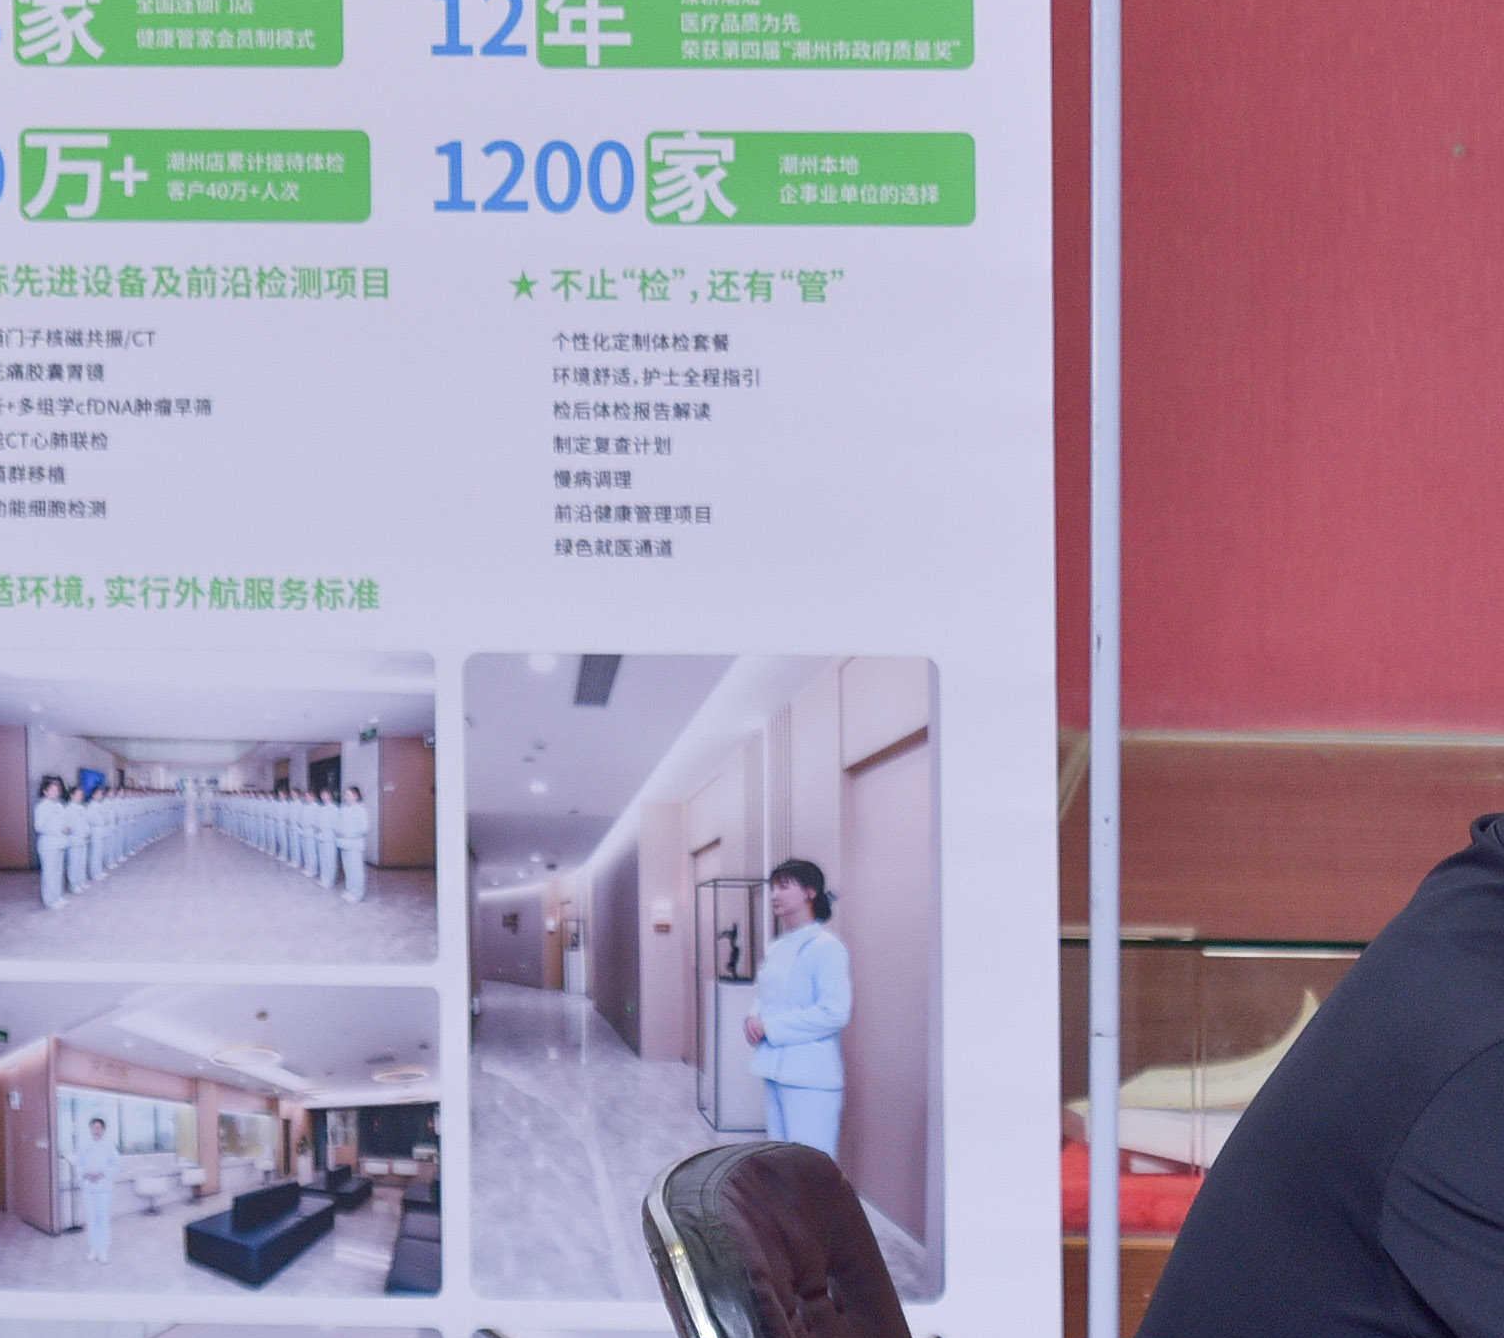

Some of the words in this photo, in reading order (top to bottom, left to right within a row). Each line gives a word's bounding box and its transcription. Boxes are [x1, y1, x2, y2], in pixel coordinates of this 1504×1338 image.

[679, 12, 801, 34] 医疗品质为先
[135, 28, 316, 51] 健康管家会员制模式
[166, 150, 345, 174] 潮州店累计接待体检
[779, 155, 860, 177] 潮州本地
[166, 180, 299, 202] 客户40万+人次
[779, 183, 941, 205] 企事业单位的选择
[551, 332, 730, 353] 个性化定制体检套餐
[551, 400, 713, 422] 检后体检报告解读
[551, 435, 672, 457] 制定复查计划
[552, 469, 632, 490] 慢病调理
[553, 503, 713, 525] 前沿健康管理项目
[553, 537, 674, 559] 绿色就医通道
